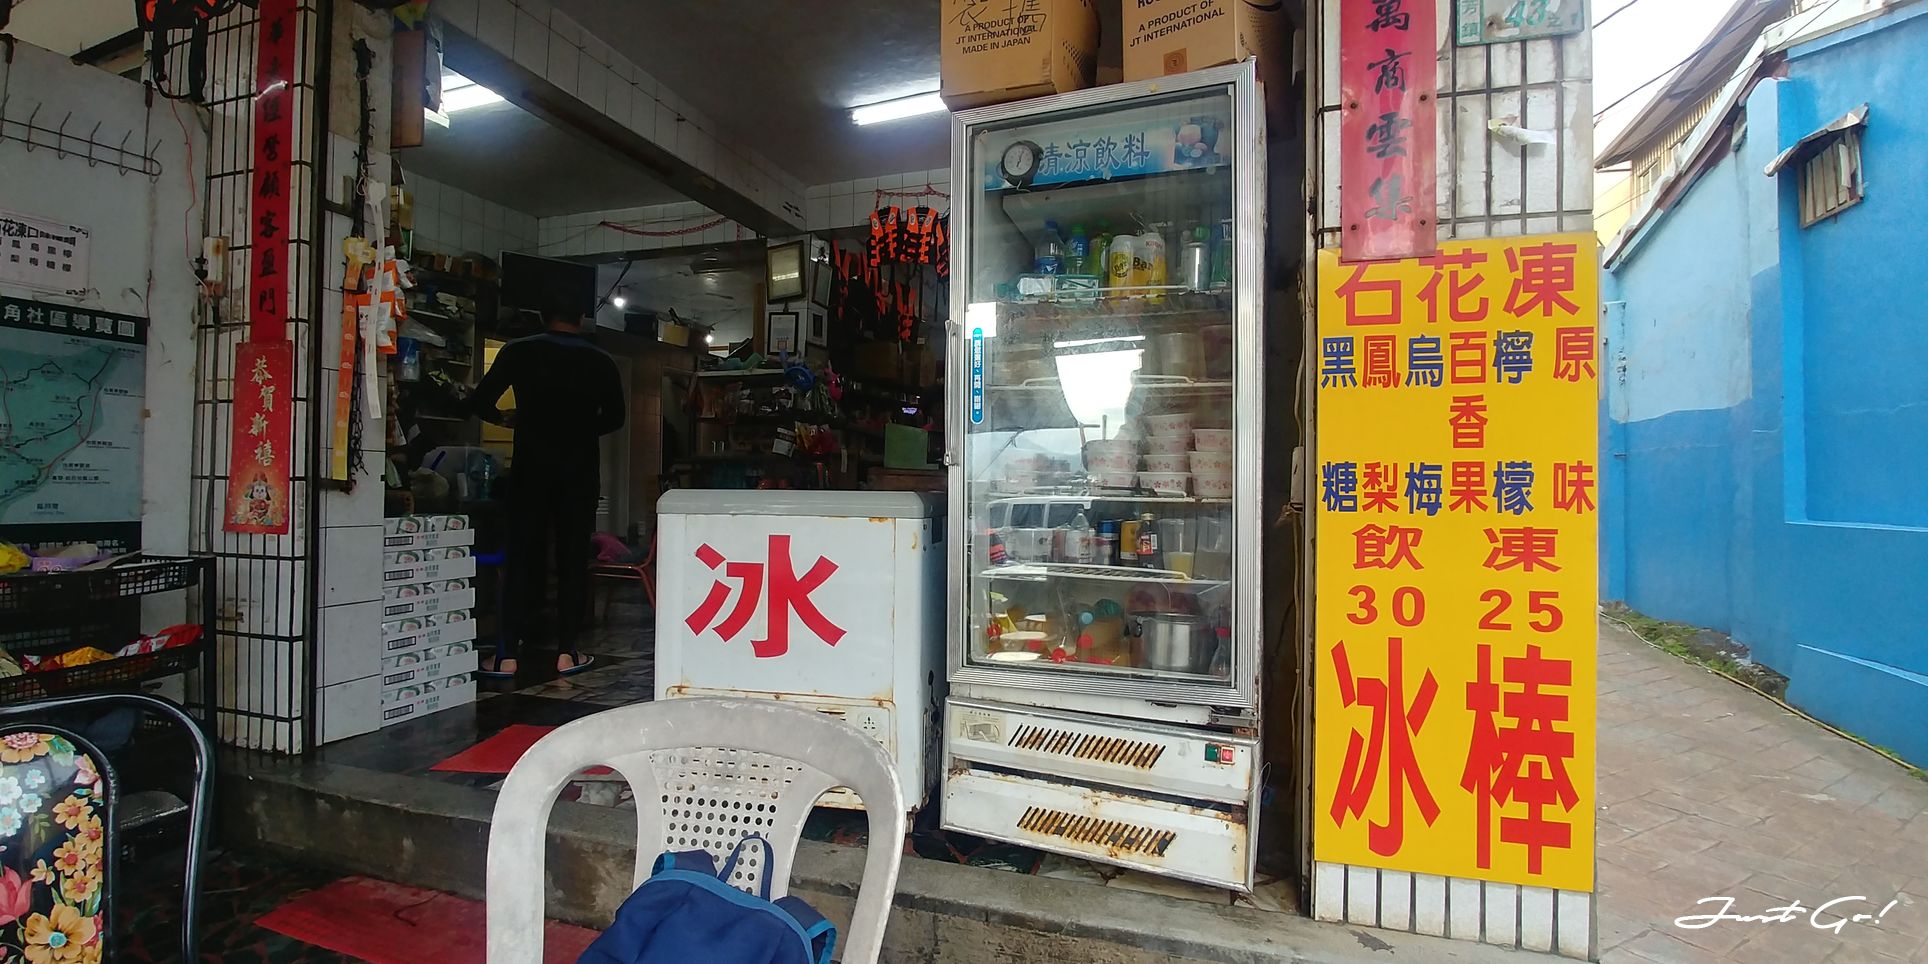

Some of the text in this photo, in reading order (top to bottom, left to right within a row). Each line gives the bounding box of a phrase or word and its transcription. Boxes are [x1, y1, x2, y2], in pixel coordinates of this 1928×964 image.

[956, 25, 1038, 45] JT INTERNATIONAL
[973, 18, 1014, 31] PRODUCT
[1017, 15, 1029, 24] OF
[1130, 7, 1225, 47] JT INTERNATIONAL
[1138, 24, 1145, 32] A
[1148, 4, 1197, 29] PRODUCT
[1200, 0, 1215, 9] OF
[962, 36, 1031, 55] MADE IN JAPAN
[1364, 0, 1412, 221] 萬商雲集
[1335, 242, 1580, 326] 石花凍
[248, 355, 276, 467] 恭賀新禧
[684, 534, 848, 658] 冰
[1346, 584, 1426, 627] 30
[1478, 588, 1564, 633] 25
[1330, 636, 1580, 876] 冰棒
